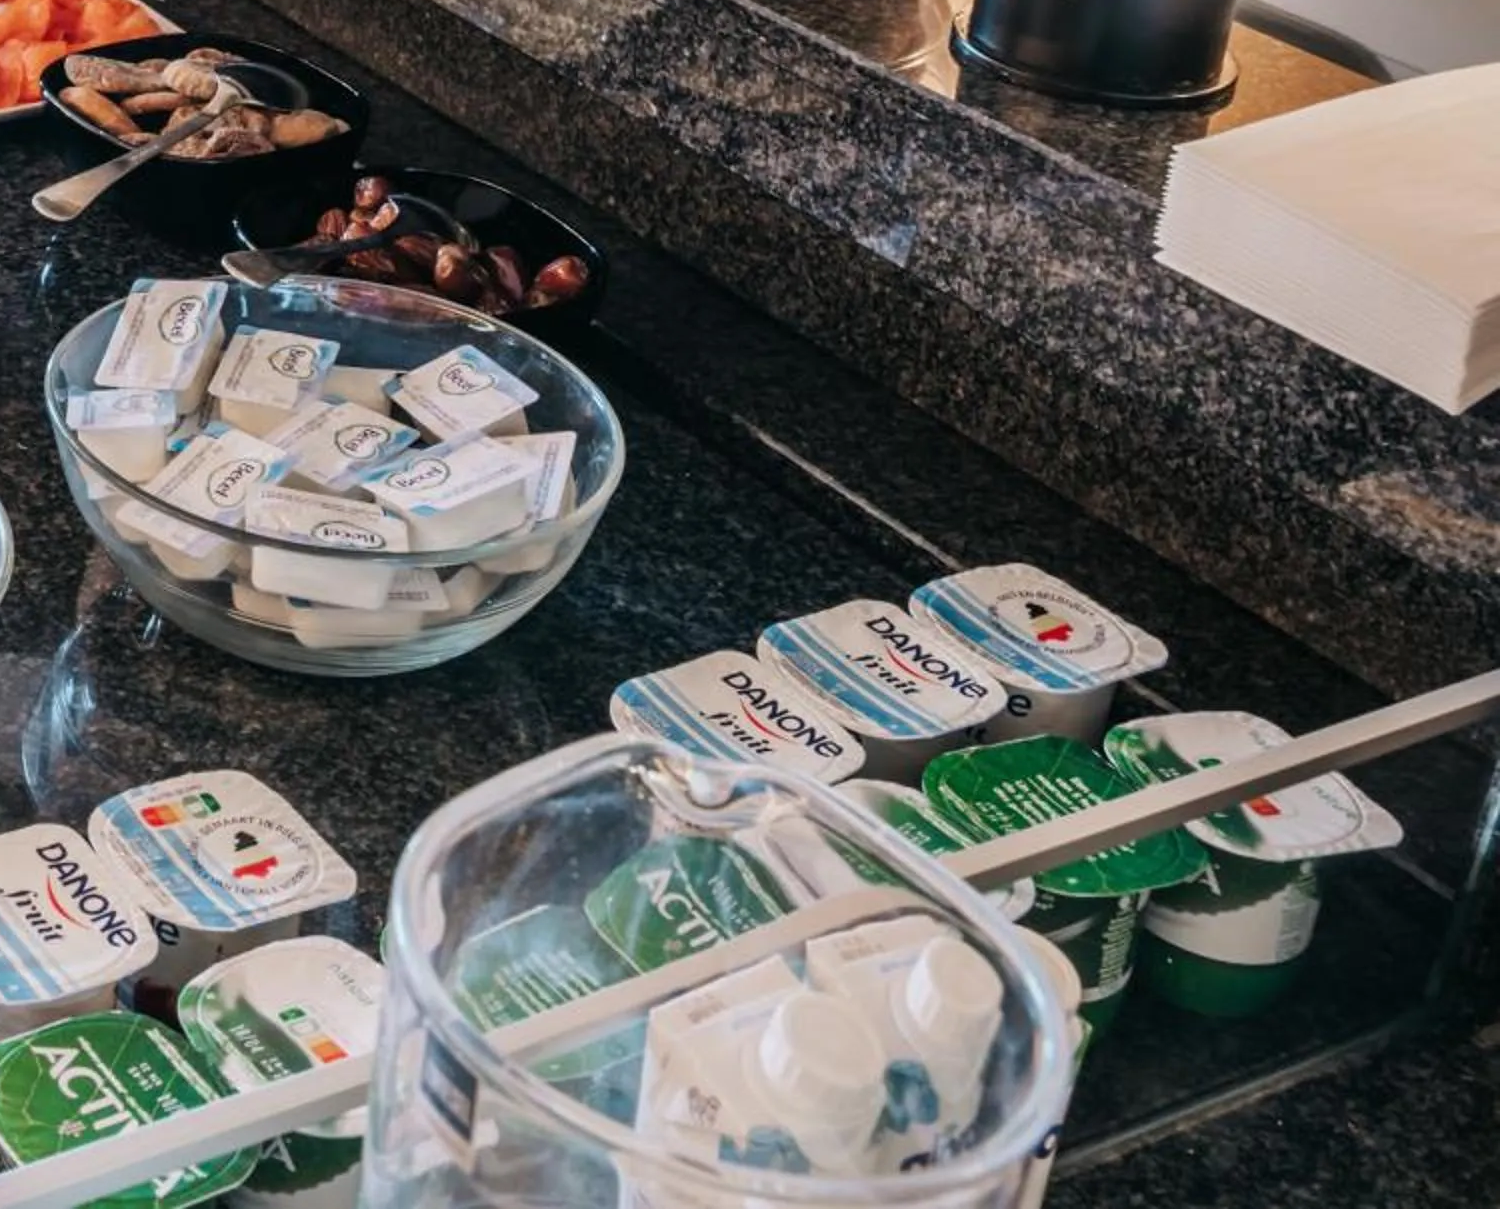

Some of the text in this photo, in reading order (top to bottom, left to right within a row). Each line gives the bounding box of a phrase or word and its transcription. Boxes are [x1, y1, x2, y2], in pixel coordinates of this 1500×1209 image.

[846, 652, 920, 696] fruit
[699, 710, 773, 755] fruit
[0, 887, 64, 944] fruit
[635, 869, 719, 948] ACTI
[29, 1039, 137, 1131] ACTI
